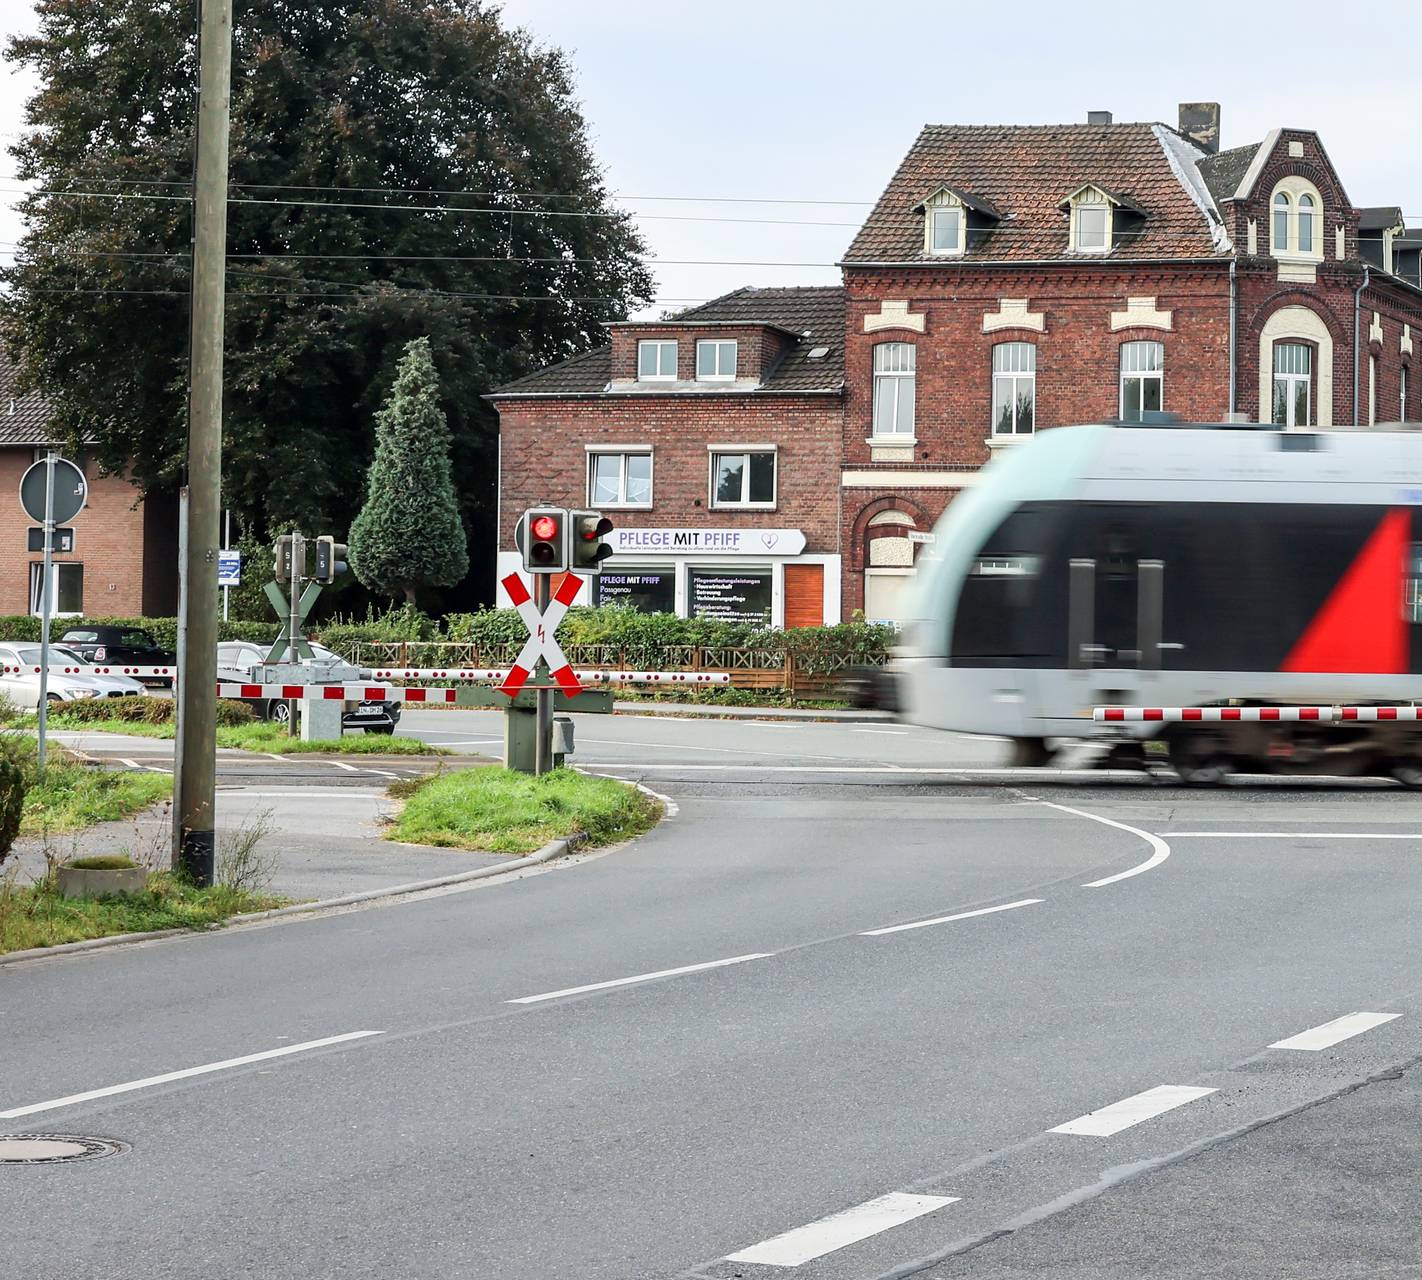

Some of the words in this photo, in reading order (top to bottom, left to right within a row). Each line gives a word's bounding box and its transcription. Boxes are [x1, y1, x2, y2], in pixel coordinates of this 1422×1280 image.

[619, 532, 670, 545] PFLEGE
[673, 532, 700, 546] MIT
[704, 532, 741, 546] PFIFF
[600, 576, 626, 584] PFLEGE
[626, 576, 640, 584] MIT
[641, 576, 660, 584] PFIFF
[600, 585, 632, 595] Passgenau
